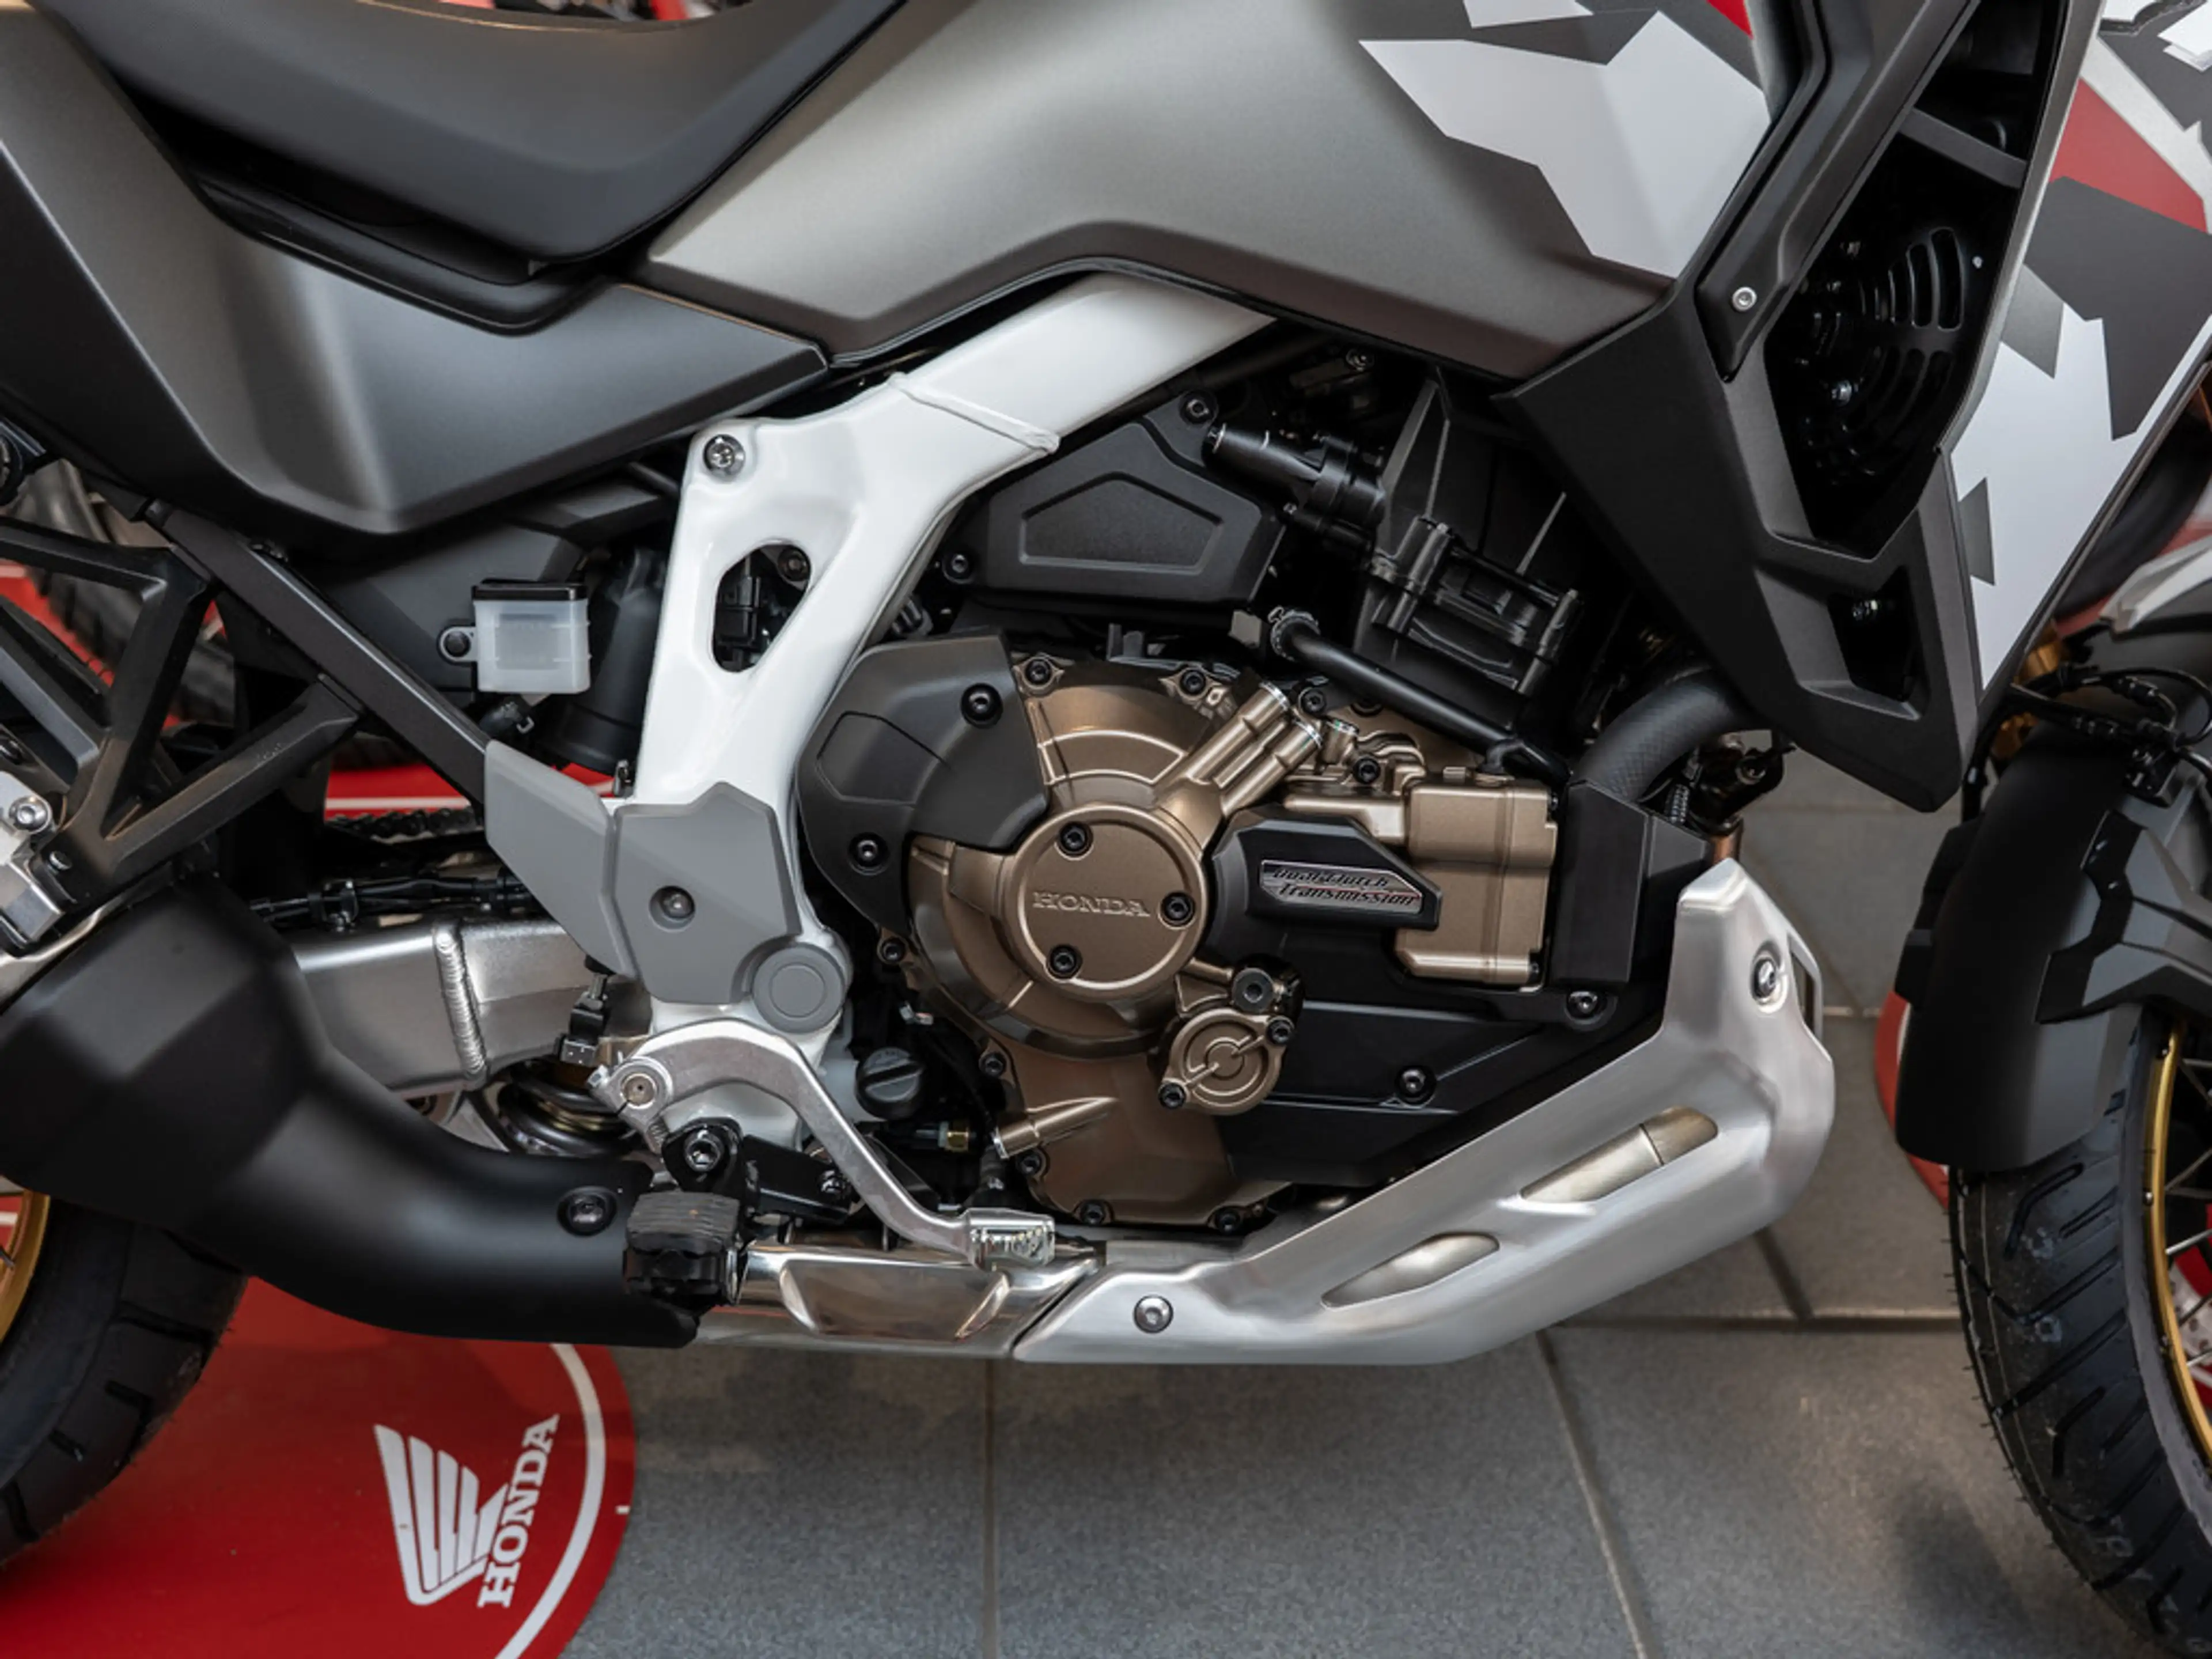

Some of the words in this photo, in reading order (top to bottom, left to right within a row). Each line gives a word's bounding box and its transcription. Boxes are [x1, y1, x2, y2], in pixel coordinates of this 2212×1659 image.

[1032, 891, 1151, 917] HONDA
[1278, 882, 1415, 906] Transmission
[477, 1414, 559, 1607] HONDA
